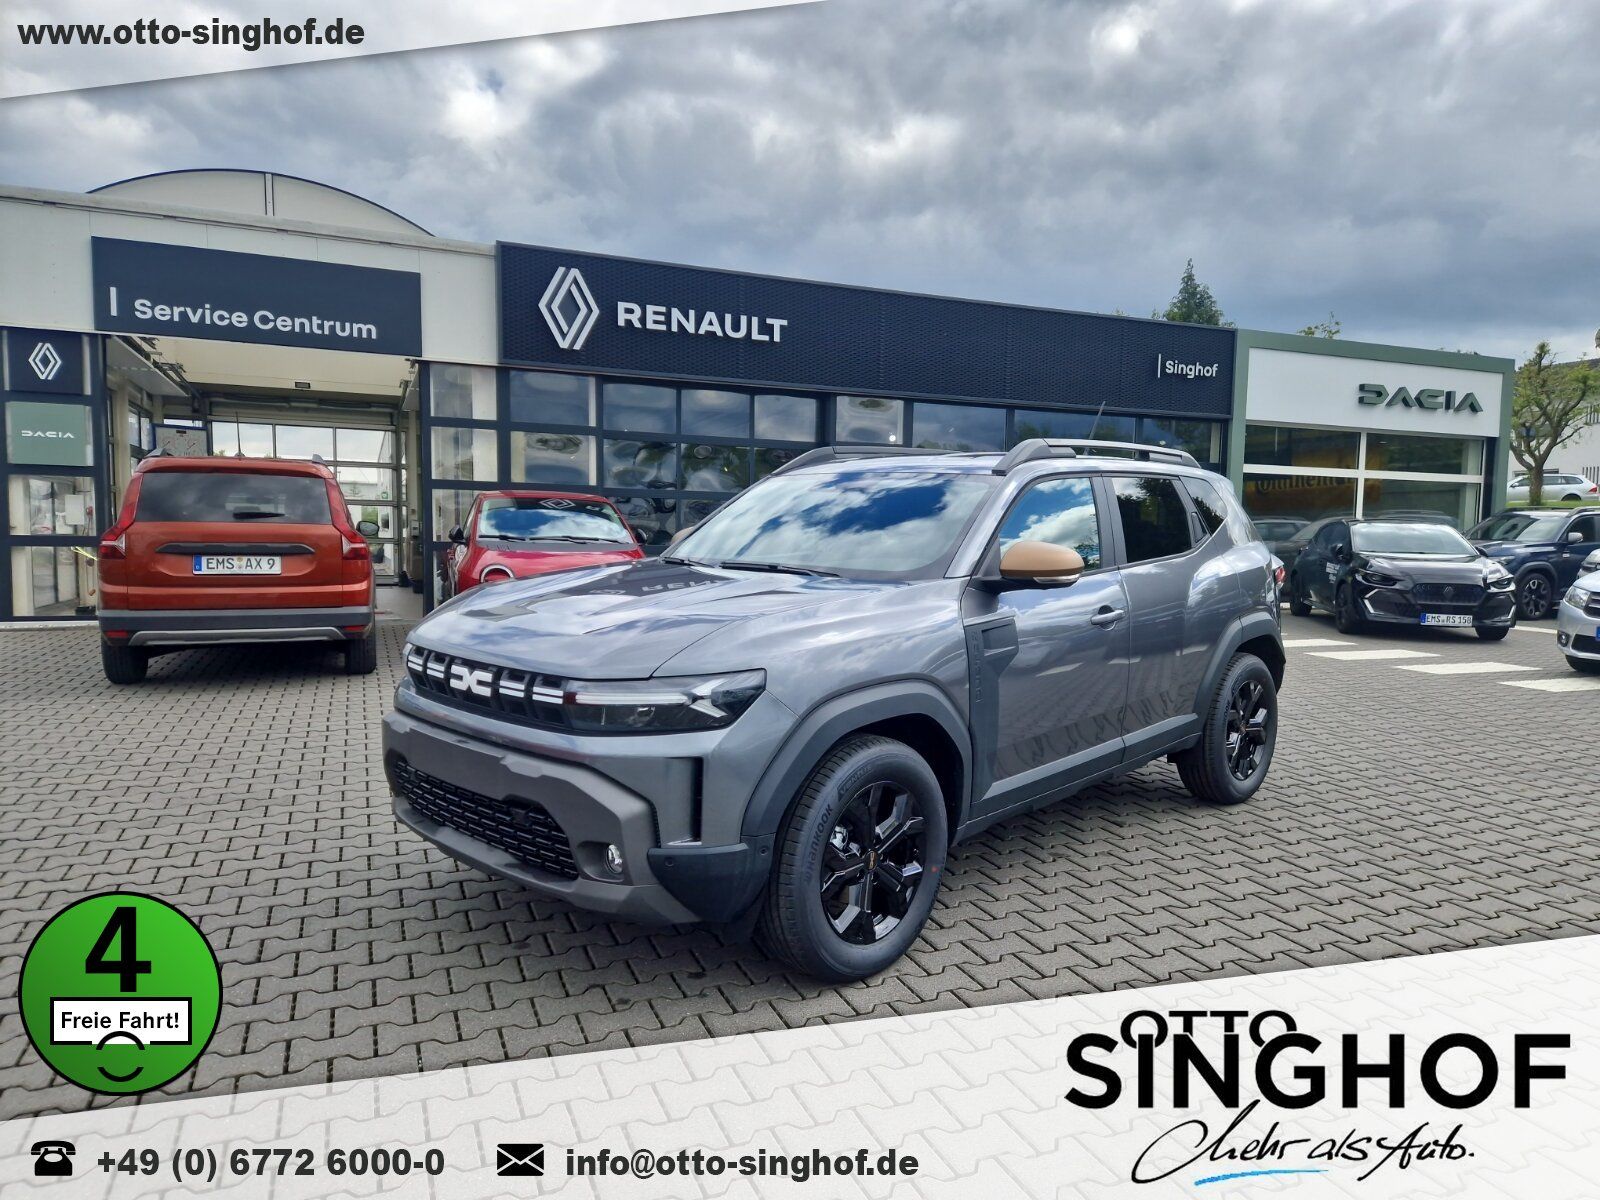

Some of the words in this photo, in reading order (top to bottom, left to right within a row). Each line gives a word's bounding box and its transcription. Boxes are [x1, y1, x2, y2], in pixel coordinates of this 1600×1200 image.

[134, 298, 248, 328] Service
[254, 310, 377, 340] Centrum
[617, 301, 788, 342] RENAULT
[1165, 360, 1219, 379] Singhof
[1358, 383, 1484, 413] DACIA
[21, 430, 75, 438] DACIA
[206, 557, 235, 570] EMS
[245, 558, 262, 570] AX
[267, 558, 275, 570] 9
[1426, 614, 1441, 623] EMS
